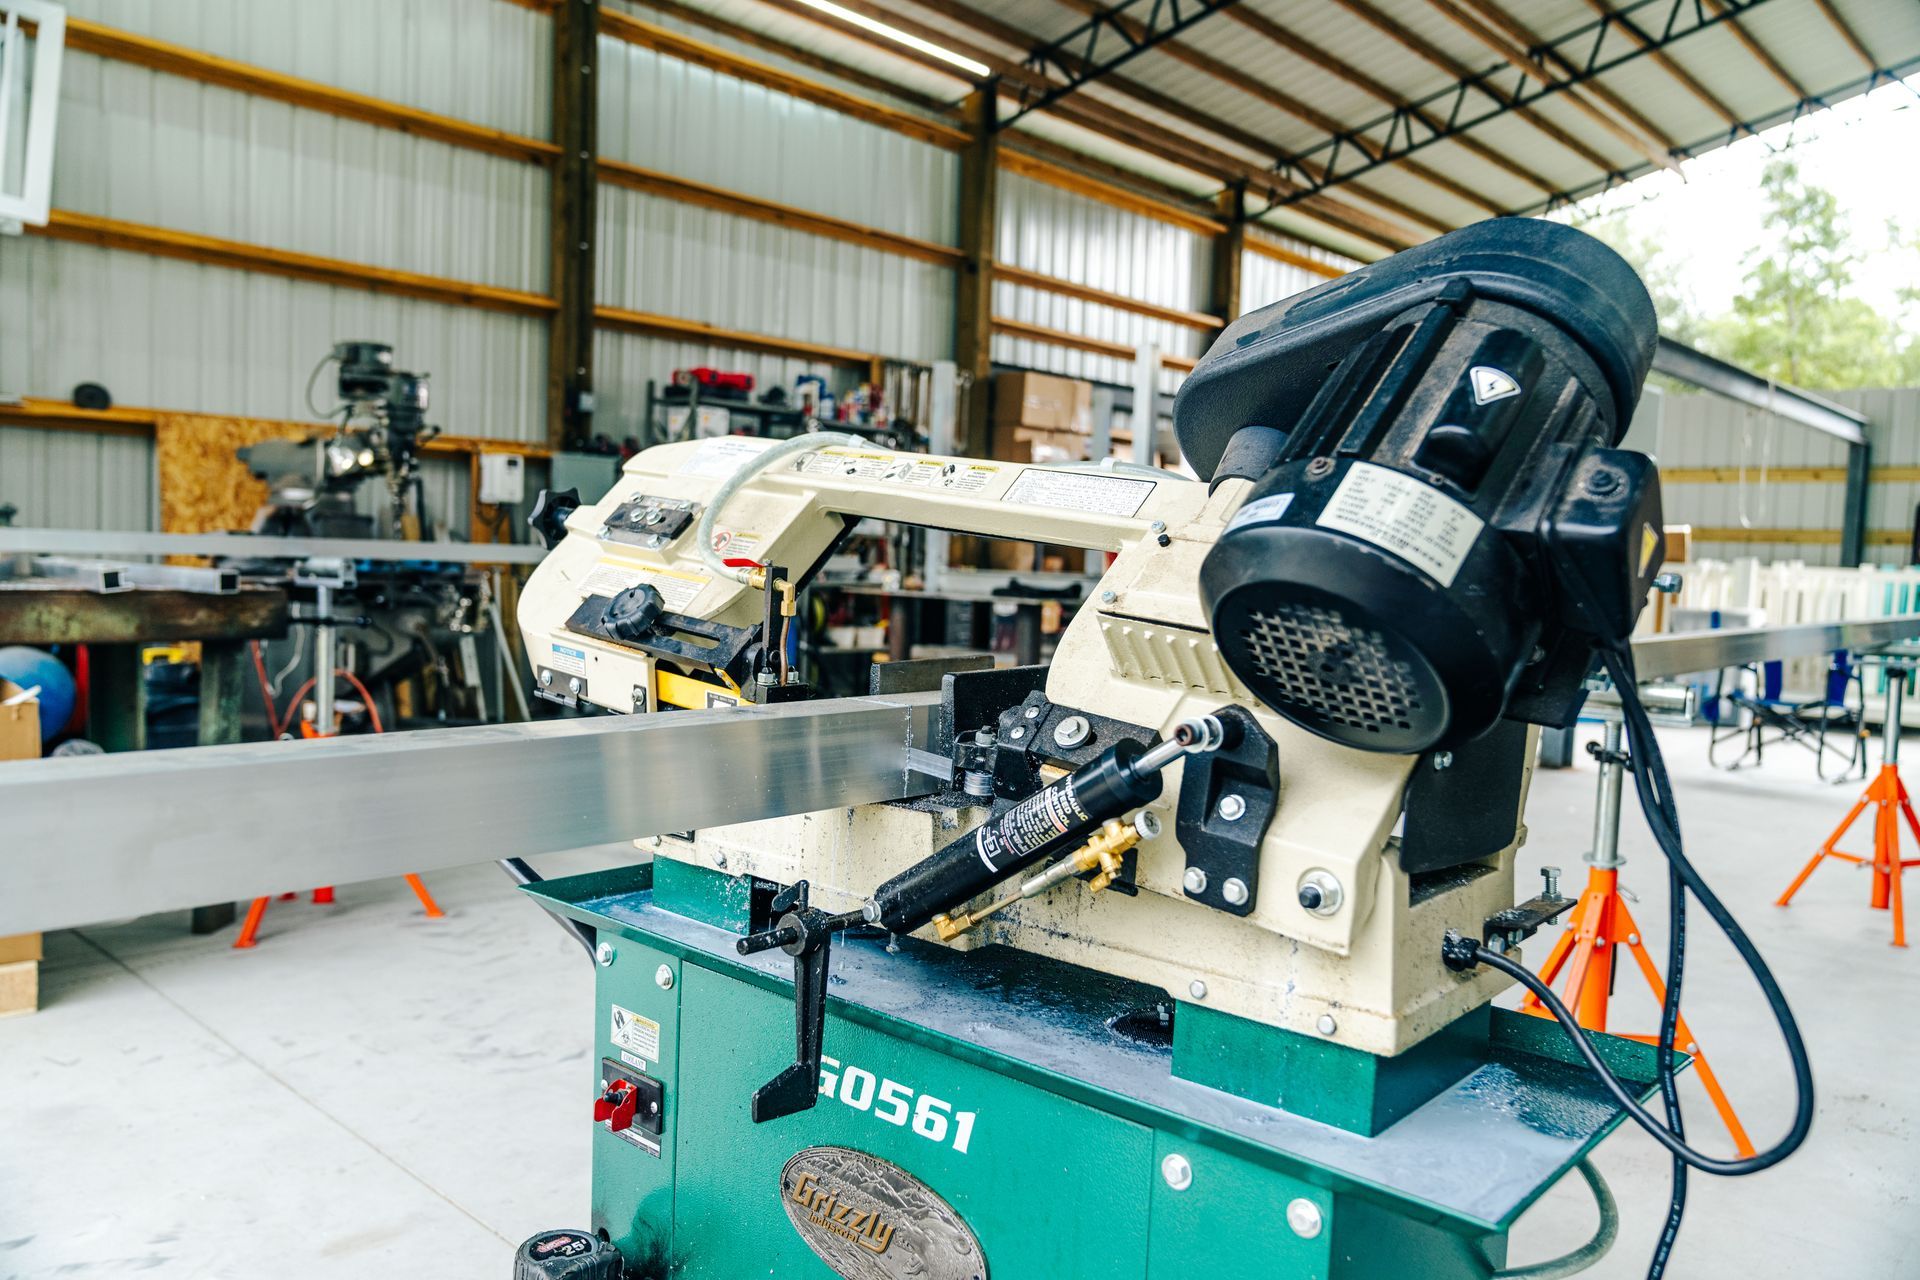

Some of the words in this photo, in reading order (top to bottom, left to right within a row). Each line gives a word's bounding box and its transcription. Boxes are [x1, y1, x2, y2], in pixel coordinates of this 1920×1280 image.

[1051, 786, 1069, 827] CONTROL
[792, 1171, 896, 1253] Grizzly
[808, 1211, 859, 1243] Industrial
